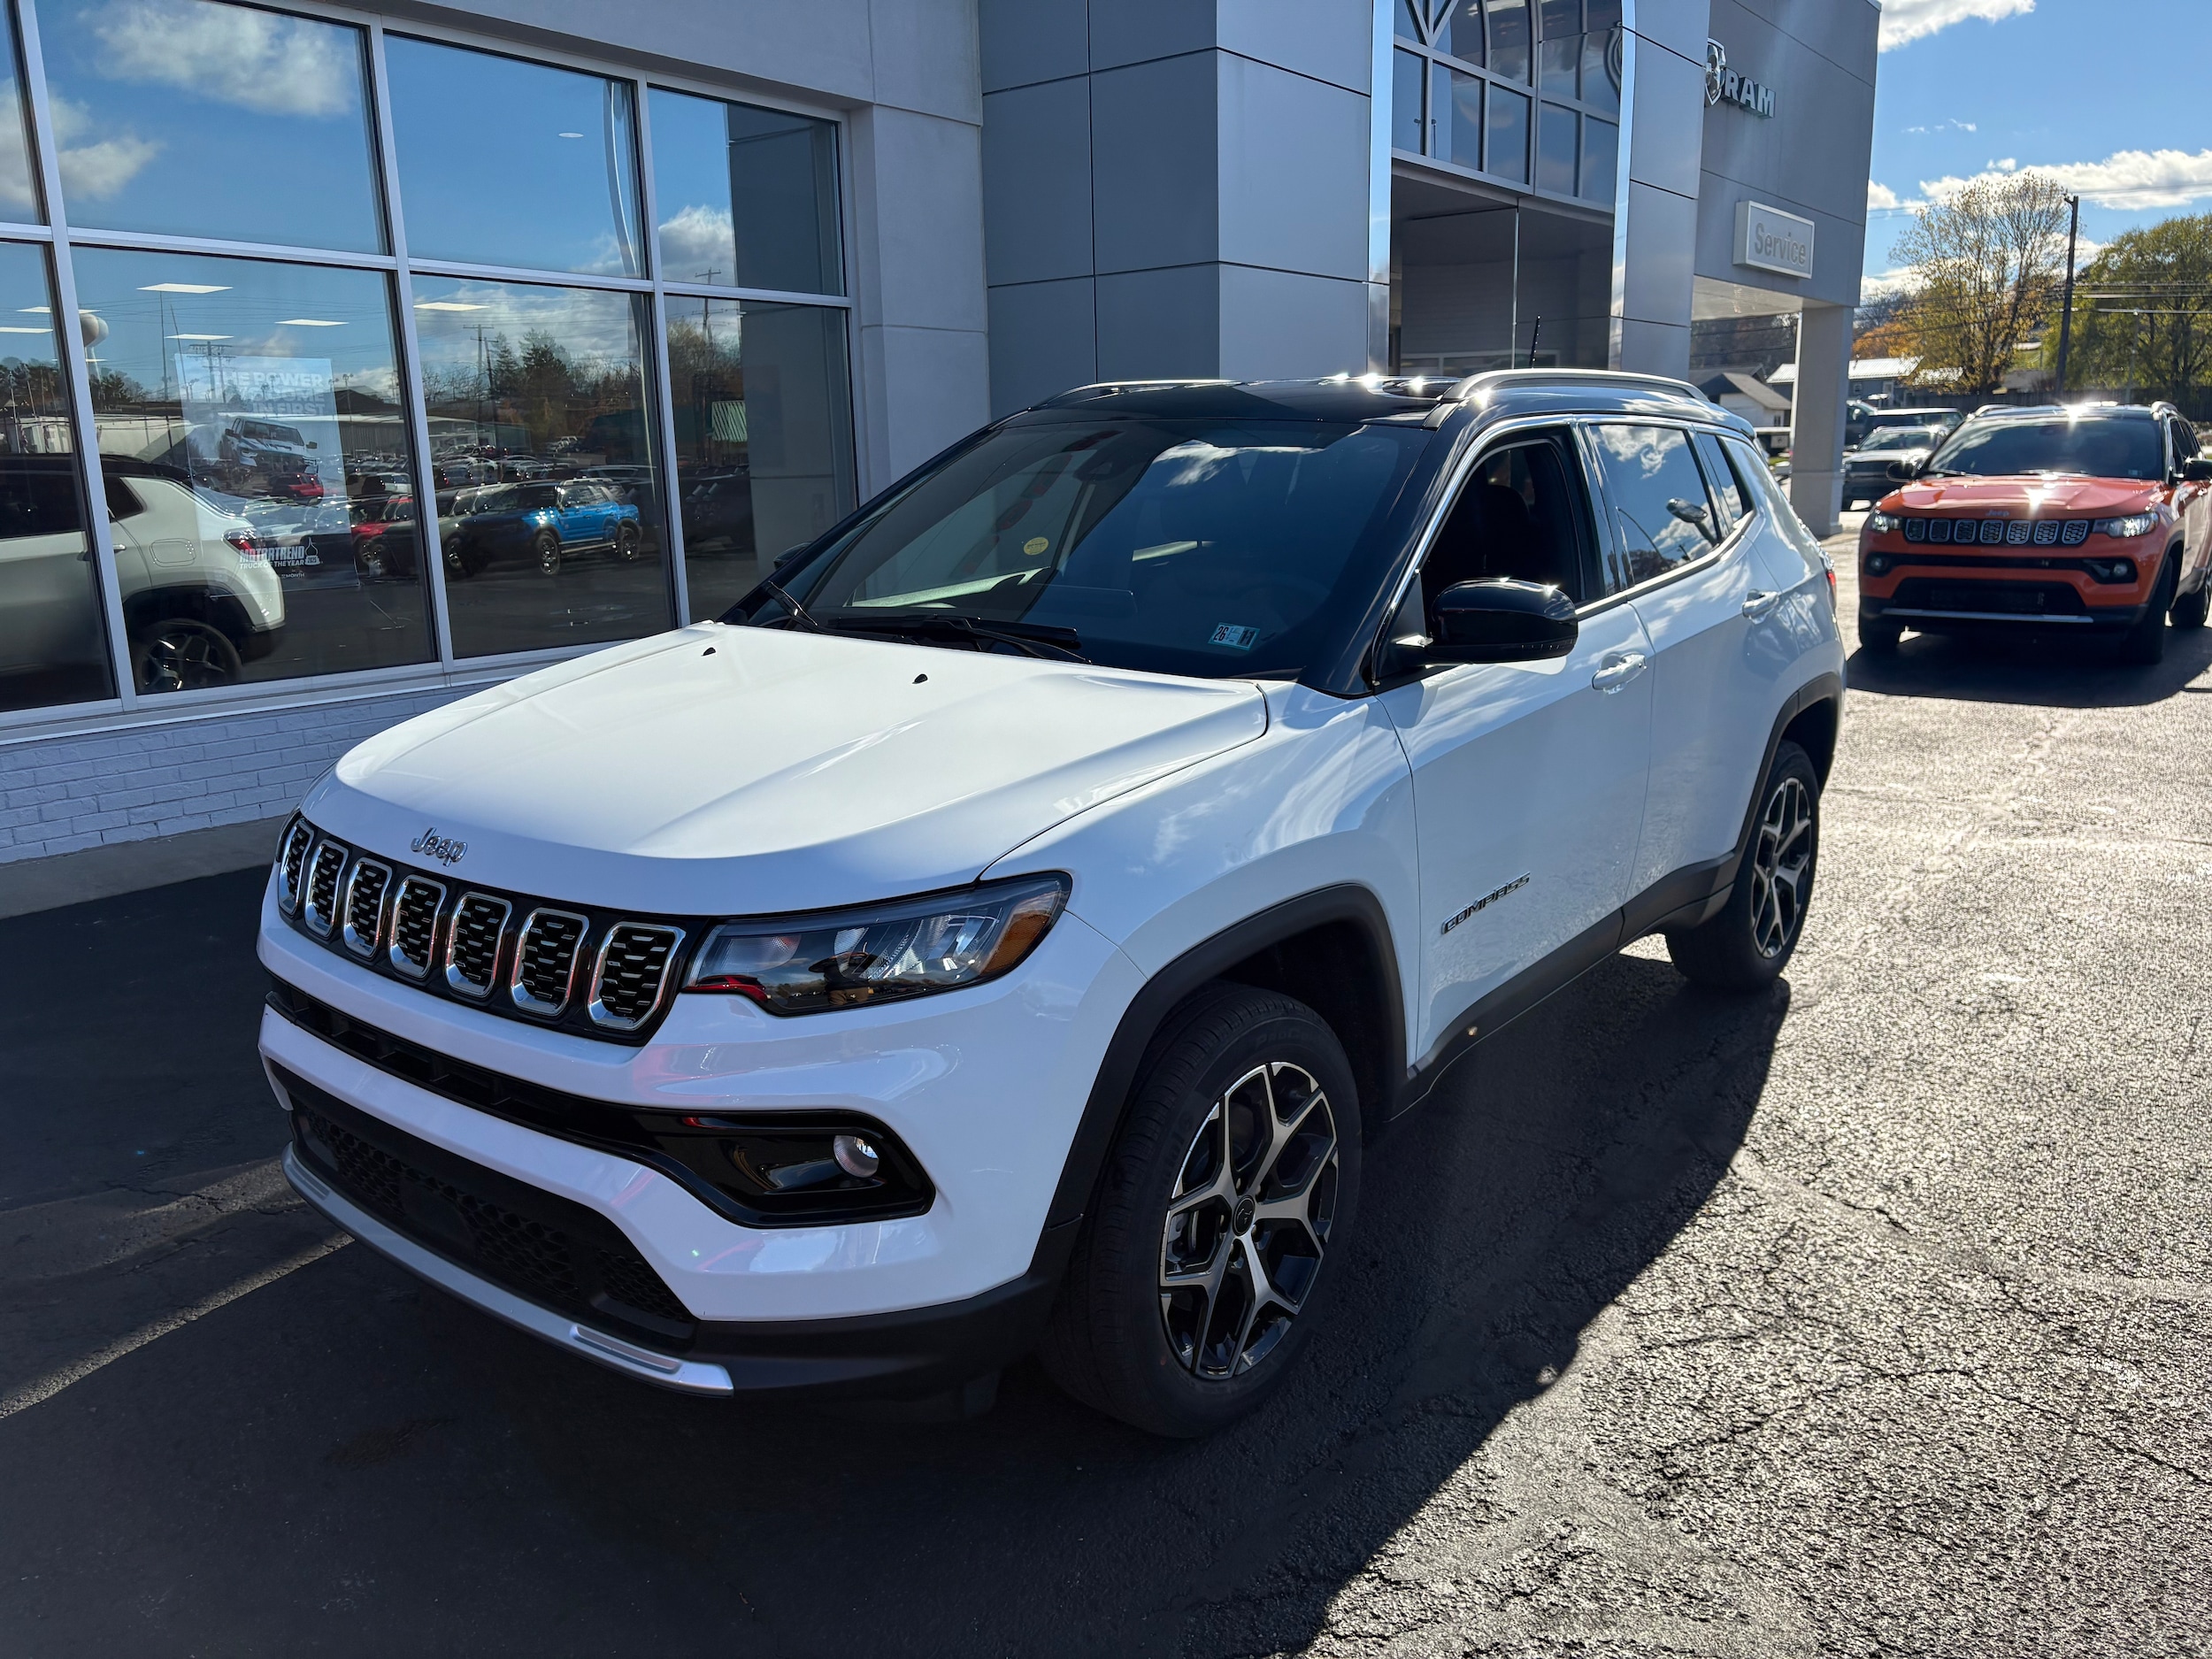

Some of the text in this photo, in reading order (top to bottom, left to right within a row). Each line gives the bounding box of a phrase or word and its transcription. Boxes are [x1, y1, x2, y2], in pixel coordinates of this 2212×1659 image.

[1724, 67, 1776, 119] RAM
[1755, 222, 1807, 265] Service
[212, 371, 324, 388] THE POWER
[252, 403, 326, 416] IN FIRST
[239, 546, 305, 563] MOTORTREND
[1213, 626, 1229, 641] 26
[411, 826, 468, 867] Jeep
[1440, 871, 1532, 934] COMPASS
